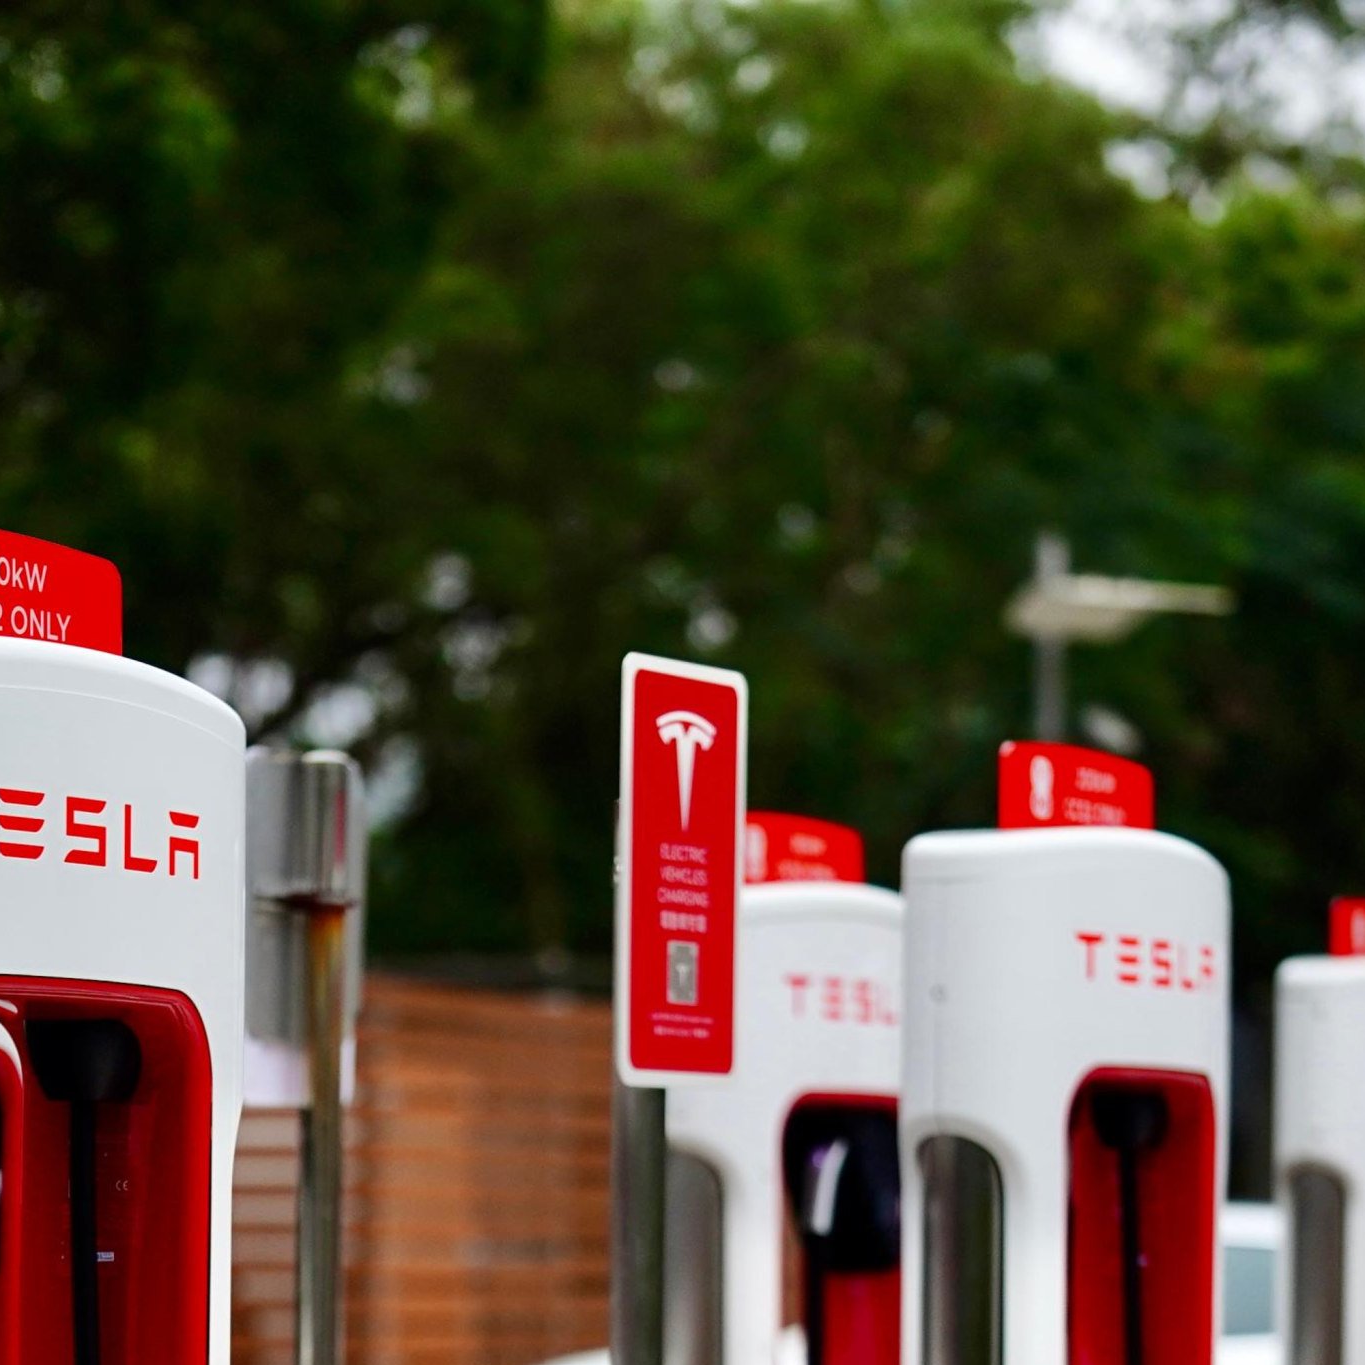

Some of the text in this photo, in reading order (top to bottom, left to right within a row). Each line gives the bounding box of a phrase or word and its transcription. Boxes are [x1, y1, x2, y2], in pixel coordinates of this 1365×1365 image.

[10, 605, 71, 642] ONLY
[1075, 930, 1214, 992] TESLA
[782, 971, 901, 1028] TESL
